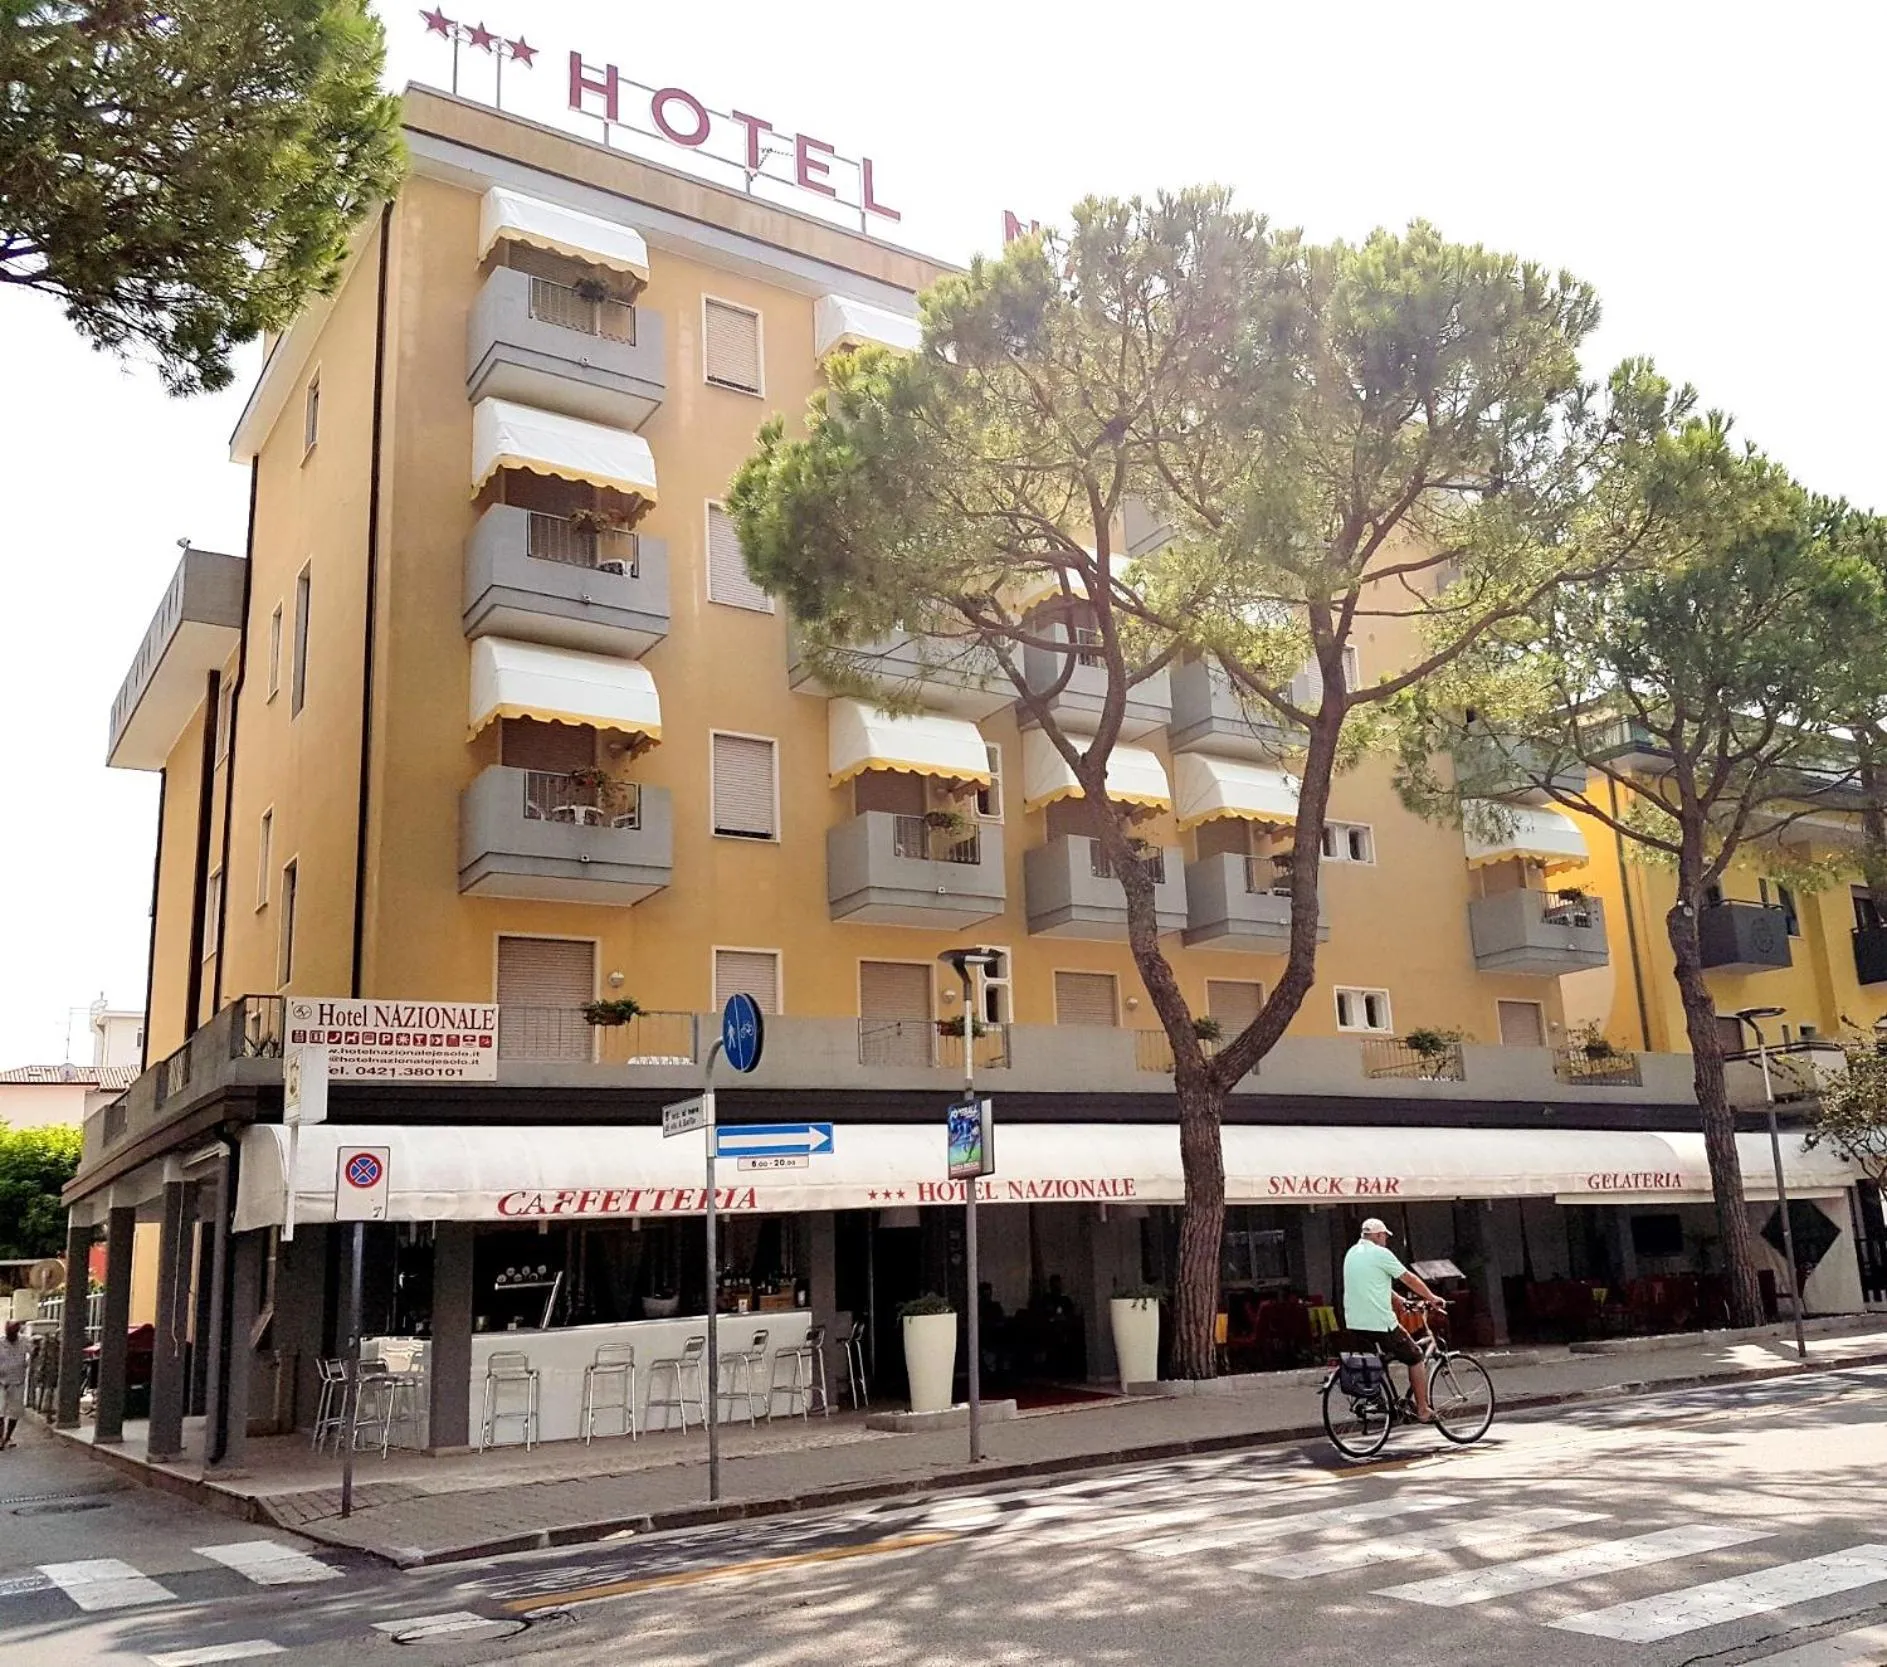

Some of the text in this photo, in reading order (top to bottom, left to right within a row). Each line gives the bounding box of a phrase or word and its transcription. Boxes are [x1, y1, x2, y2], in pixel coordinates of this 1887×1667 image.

[568, 50, 901, 222] HOTEL
[317, 1002, 496, 1031] Hotel NAZIONALE
[328, 1066, 463, 1078] el. 0421.380101
[917, 1178, 1136, 1202] HOTEL NAZIONALE
[1268, 1176, 1344, 1195] SNACK
[1355, 1177, 1401, 1194] BAR
[1588, 1173, 1682, 1189] GELATERIA
[497, 1187, 758, 1216] CAFFETTERIA
